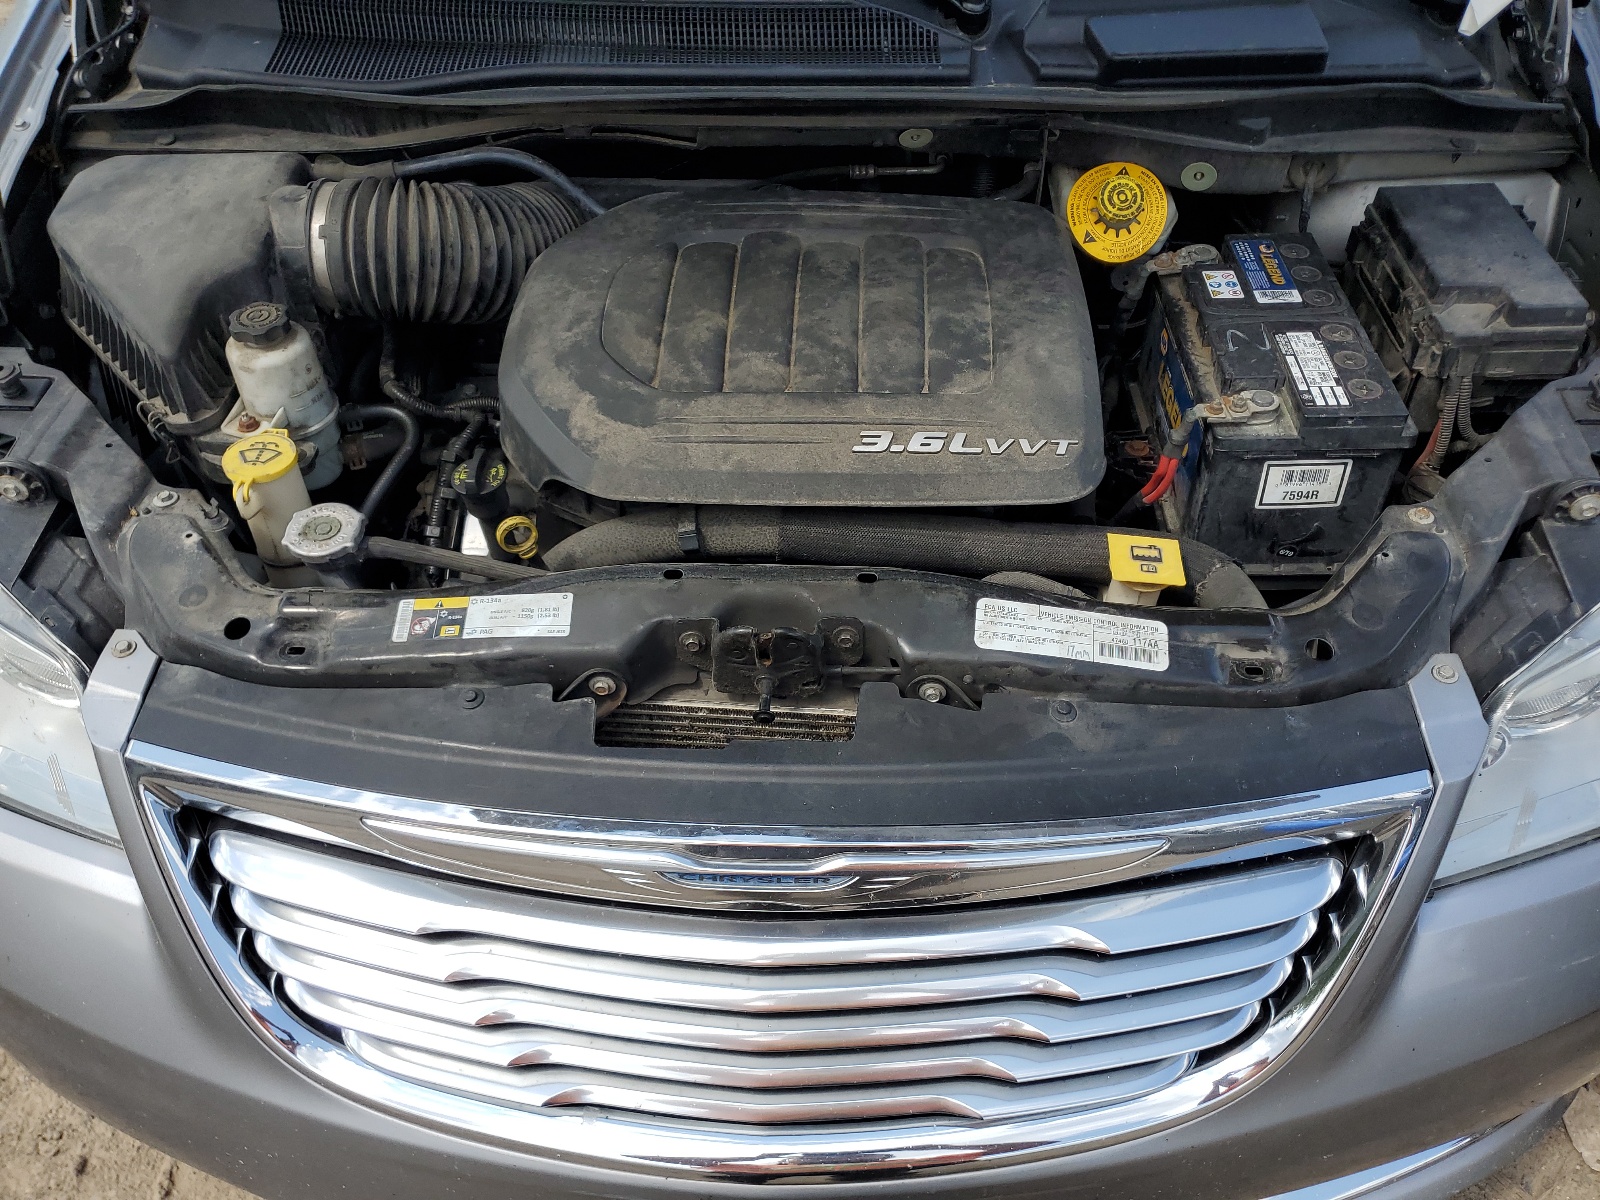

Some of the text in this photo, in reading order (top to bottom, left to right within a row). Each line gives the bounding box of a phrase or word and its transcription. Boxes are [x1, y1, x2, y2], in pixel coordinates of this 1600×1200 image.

[1260, 254, 1286, 285] LEGEND
[1282, 490, 1320, 501] 7594R
[984, 603, 996, 611] FCA
[1041, 611, 1064, 620] VEHICLE
[1065, 614, 1092, 623] EMISSION
[1093, 618, 1118, 627] CONTROL
[1120, 622, 1159, 632] INFORMATION
[677, 873, 831, 884] CHRYSLER
